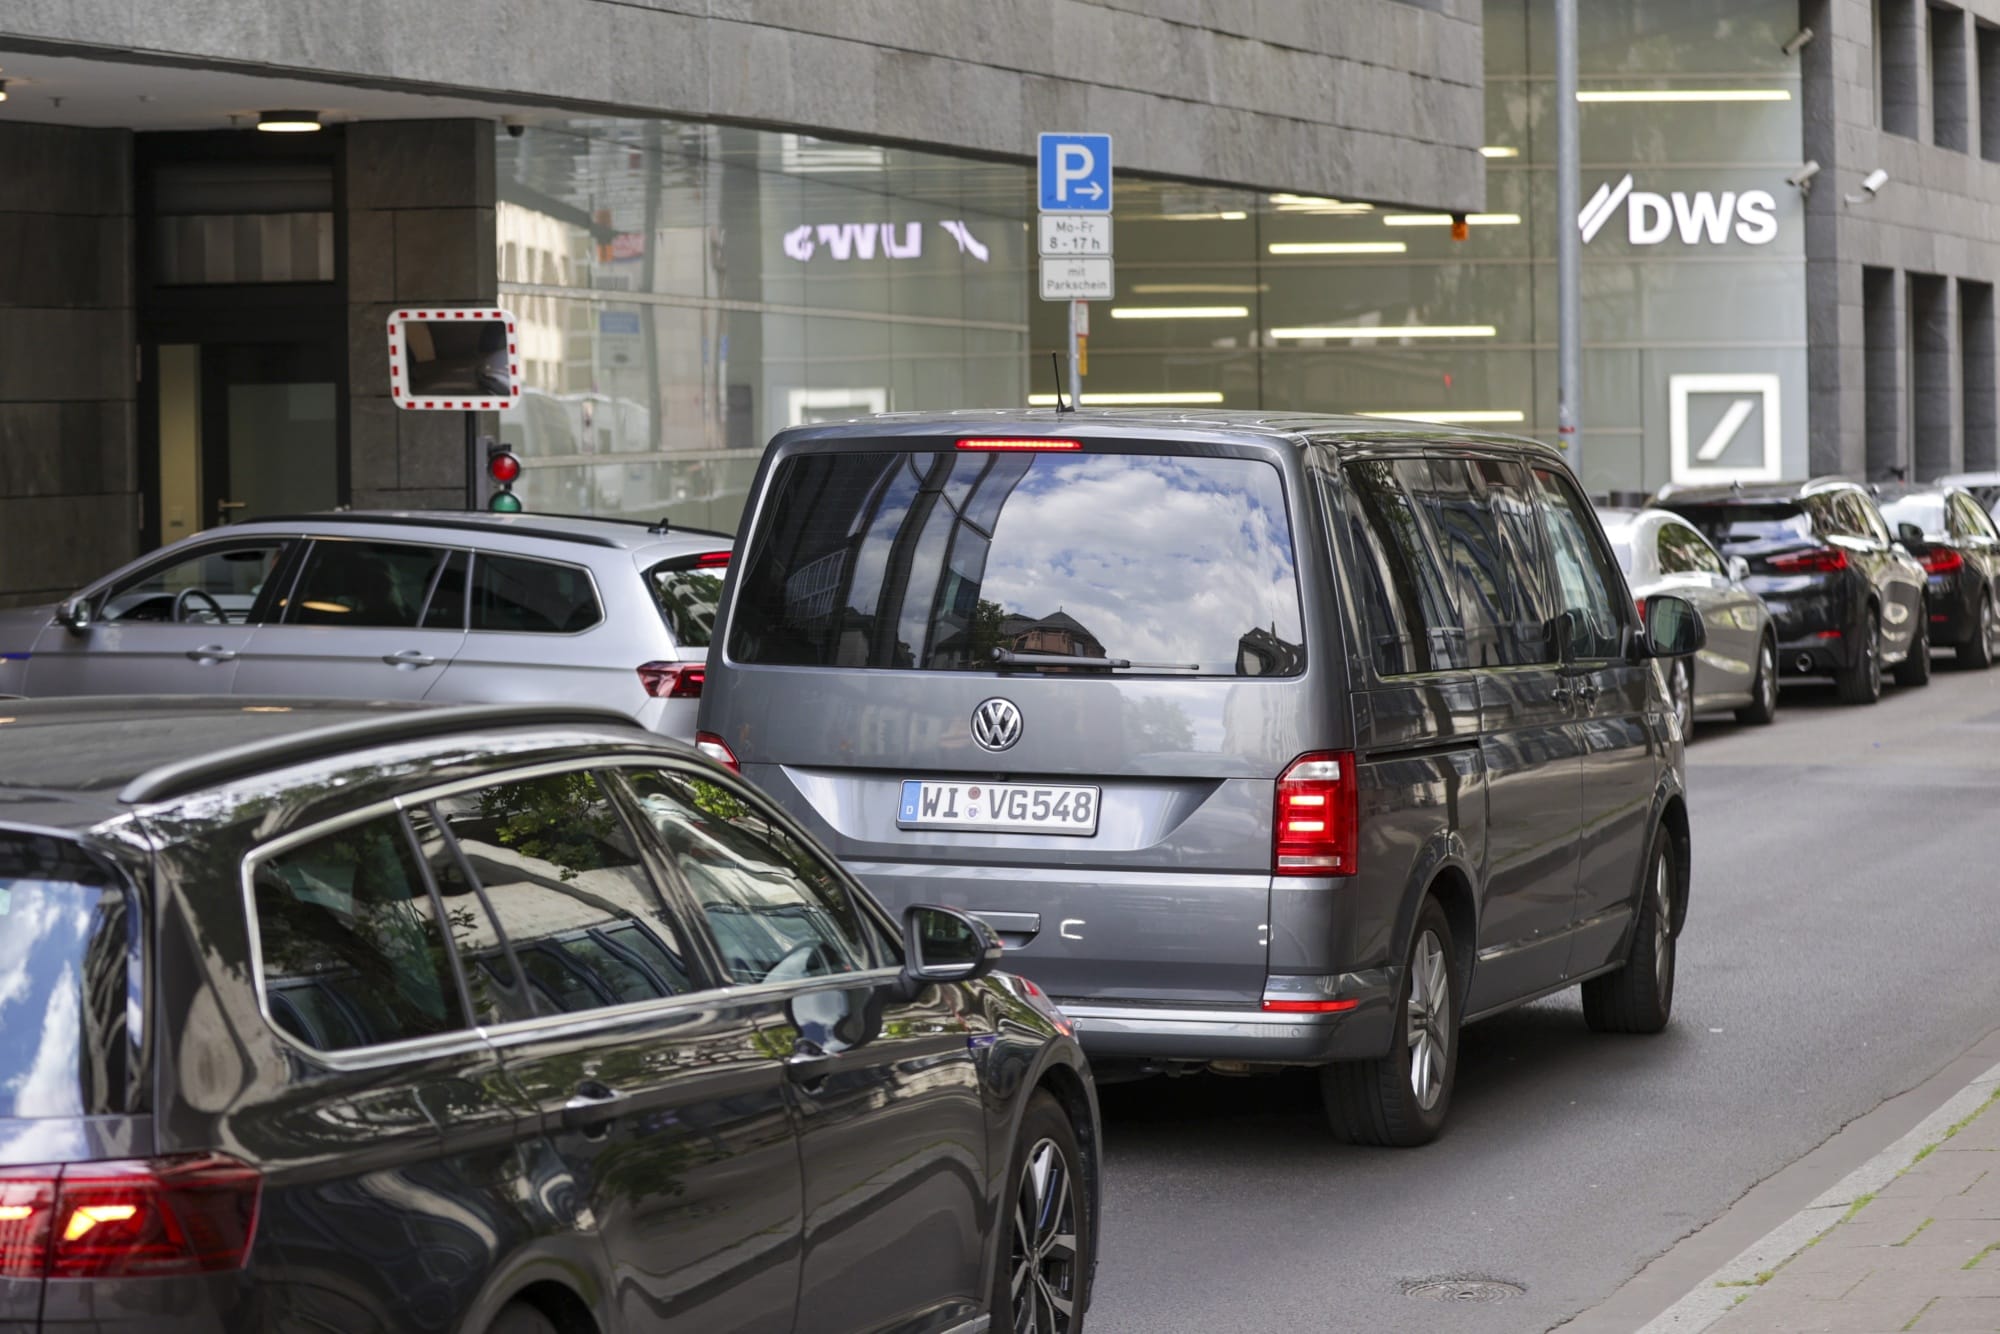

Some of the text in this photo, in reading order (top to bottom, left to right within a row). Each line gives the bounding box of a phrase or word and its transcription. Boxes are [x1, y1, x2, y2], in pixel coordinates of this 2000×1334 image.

[1056, 144, 1095, 202] P
[1627, 189, 1778, 245] DWS
[1056, 221, 1095, 233] Mo-Fr
[1049, 236, 1058, 249] 8
[1072, 237, 1087, 249] 17
[1091, 238, 1101, 250] h
[1067, 267, 1086, 277] mit
[1046, 280, 1108, 290] Parkschein
[922, 787, 959, 818] WI
[989, 788, 1092, 823] VG548
